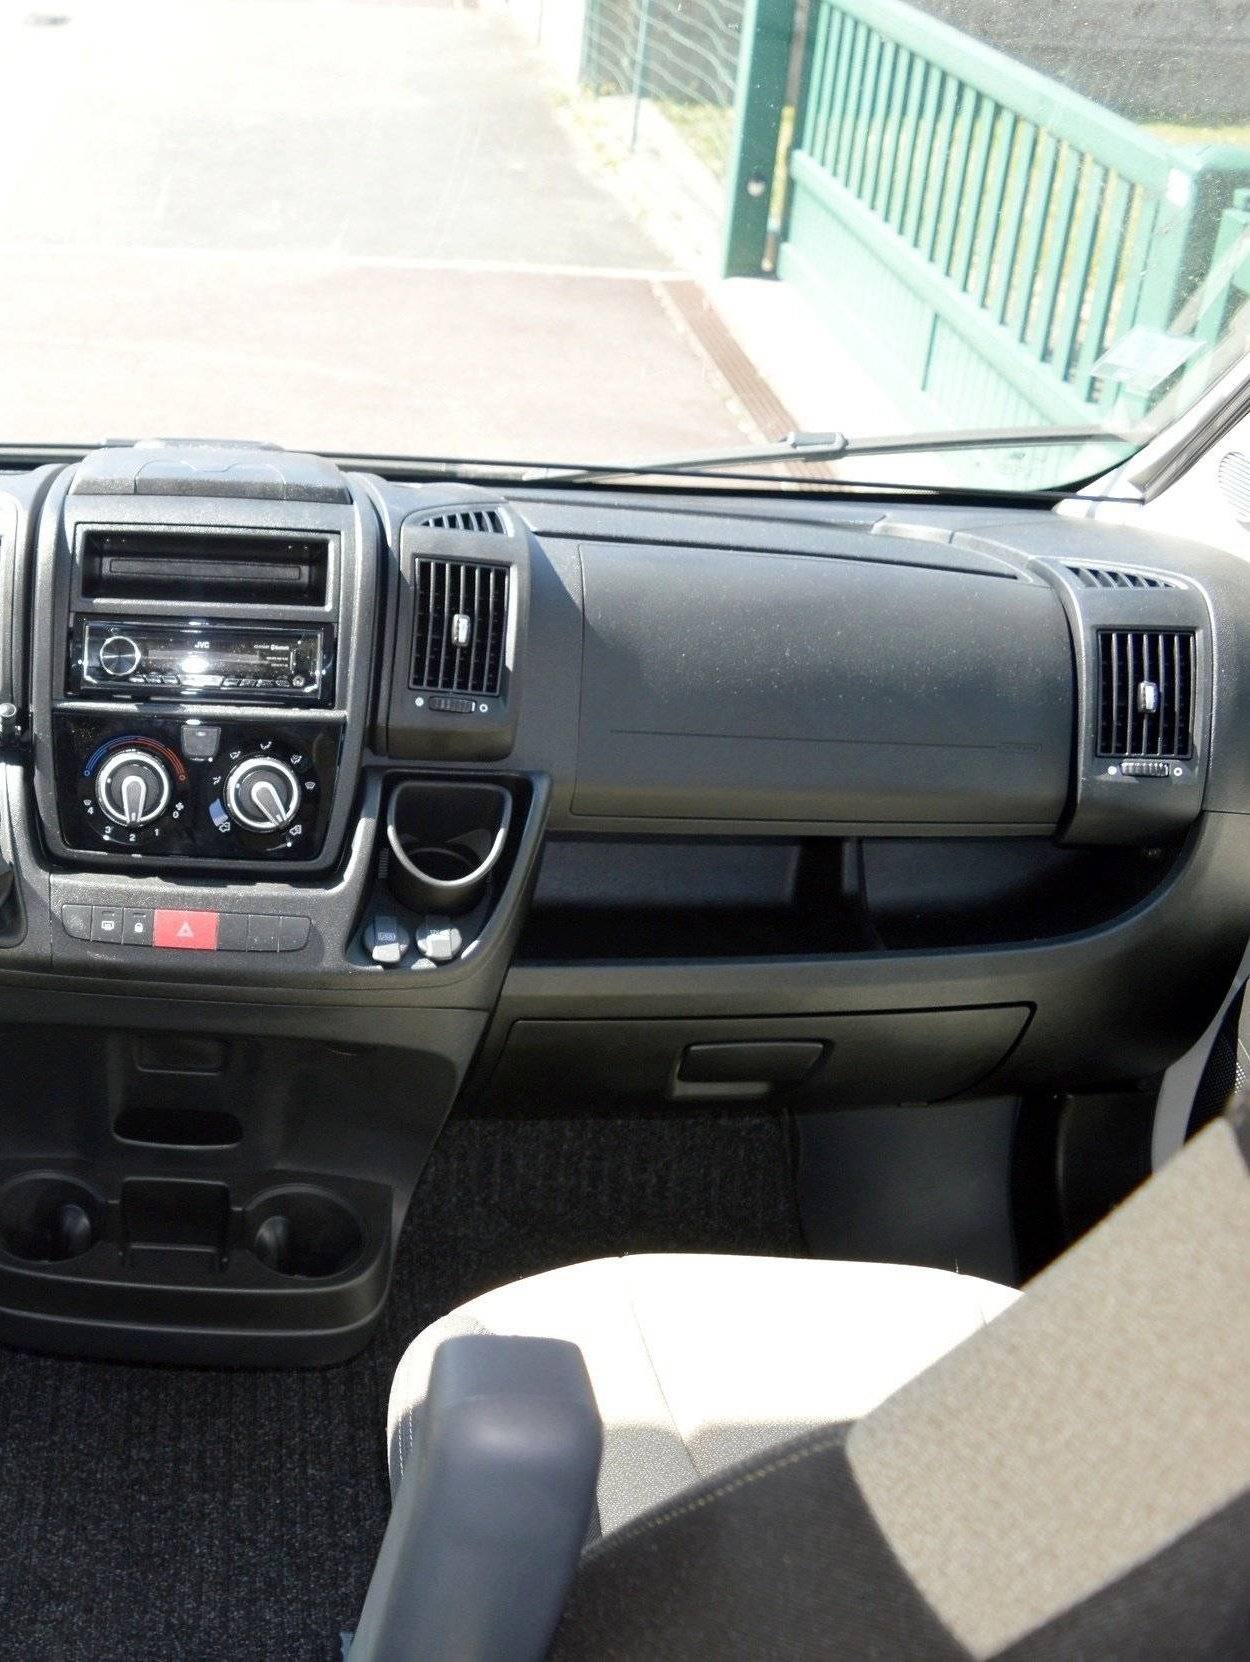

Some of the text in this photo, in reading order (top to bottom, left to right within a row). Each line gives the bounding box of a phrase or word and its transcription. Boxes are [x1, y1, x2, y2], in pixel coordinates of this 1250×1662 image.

[194, 641, 210, 649] JVC
[87, 806, 94, 815] 4
[172, 810, 179, 819] 0
[104, 826, 112, 834] 3
[154, 828, 160, 836] 1
[129, 833, 136, 842] 2
